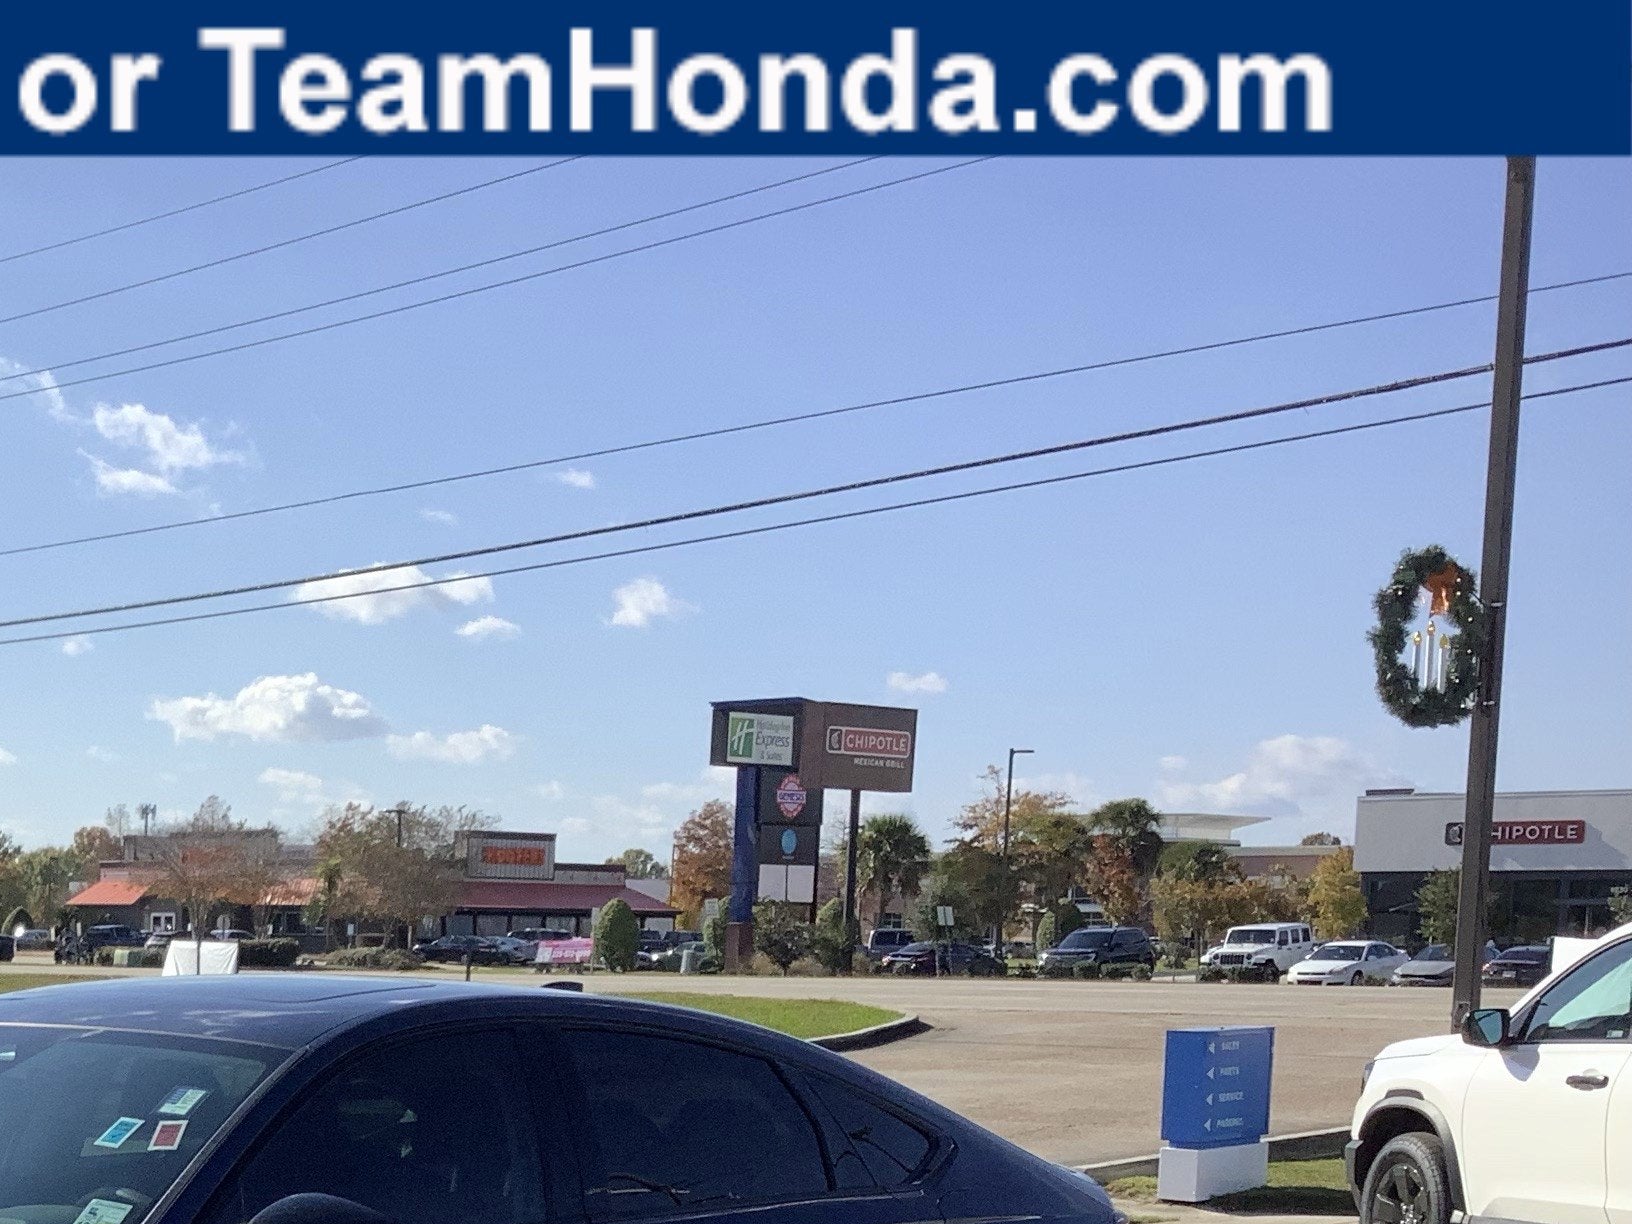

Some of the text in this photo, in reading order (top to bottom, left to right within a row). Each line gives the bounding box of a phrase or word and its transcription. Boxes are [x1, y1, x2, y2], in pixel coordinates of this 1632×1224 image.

[756, 731, 790, 749] Express
[846, 733, 907, 752] CHIPOTLE
[1490, 824, 1579, 840] HIPOTLE
